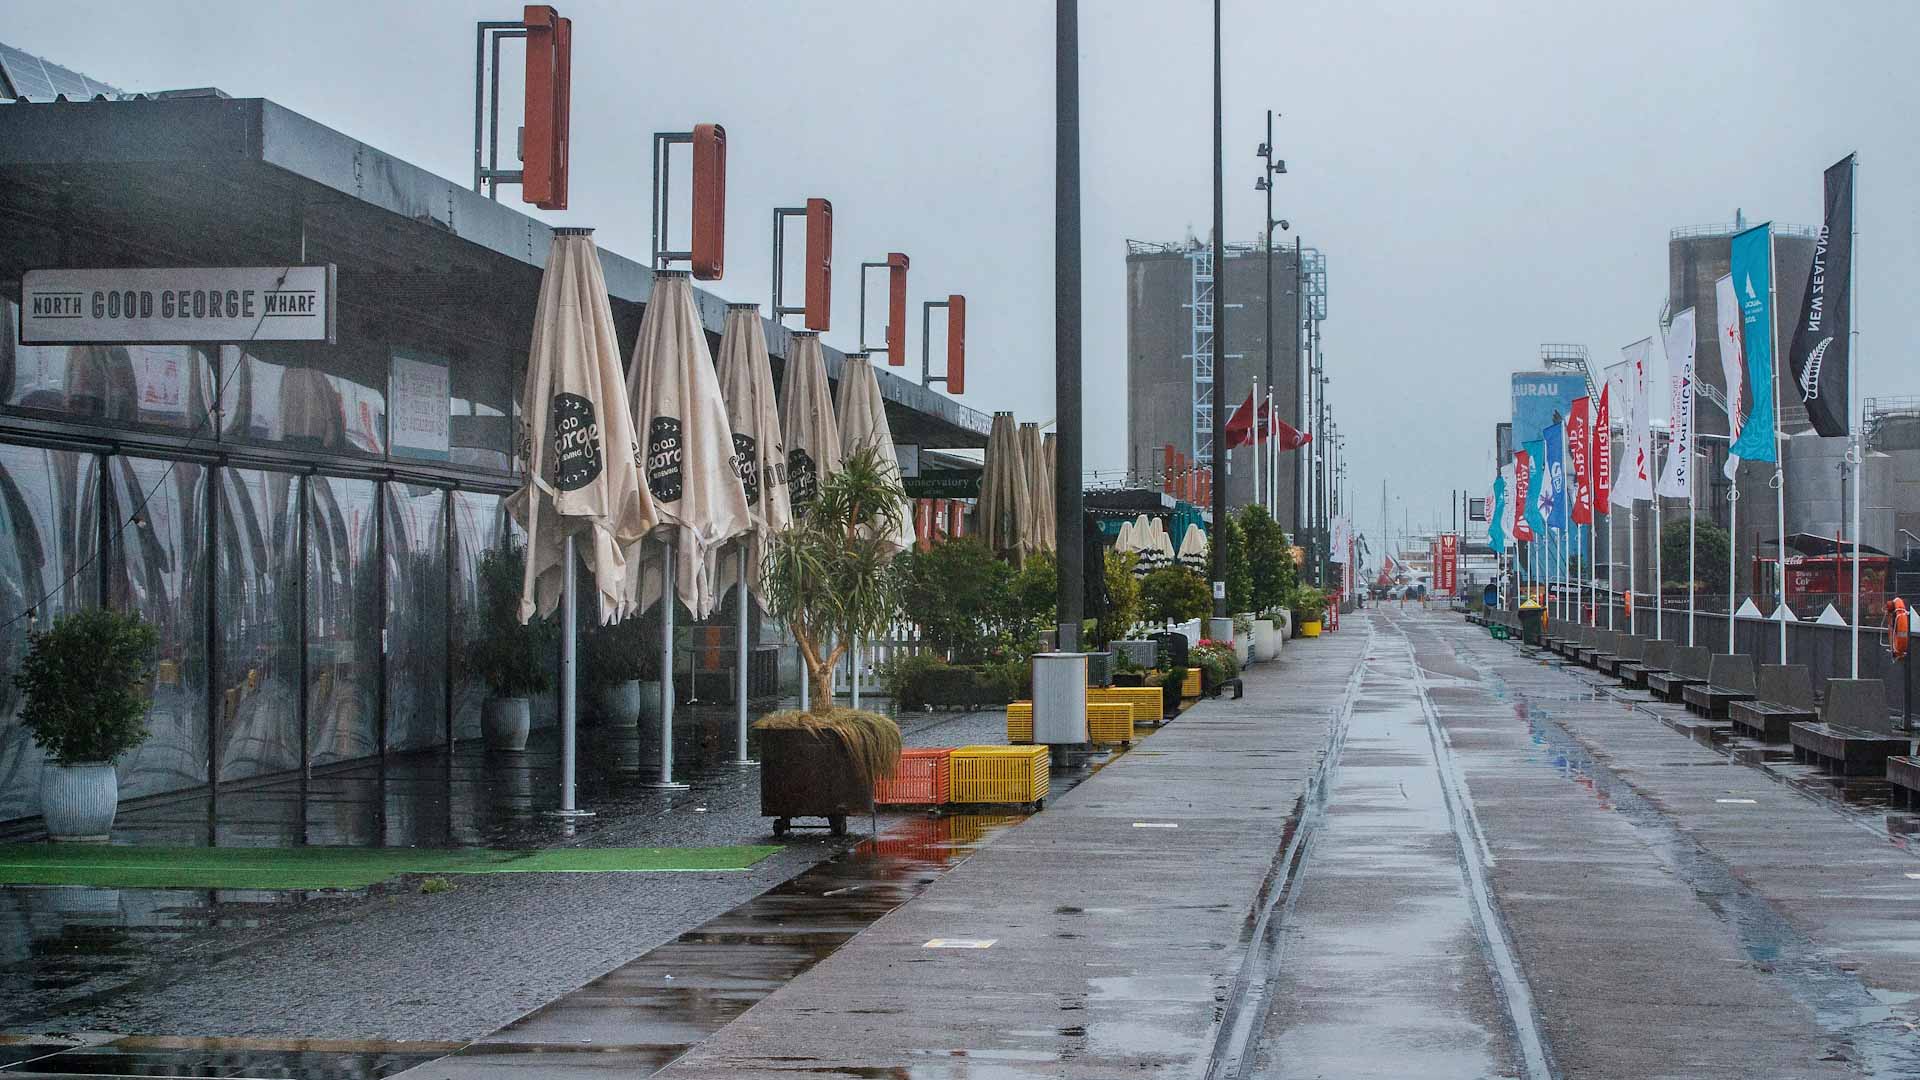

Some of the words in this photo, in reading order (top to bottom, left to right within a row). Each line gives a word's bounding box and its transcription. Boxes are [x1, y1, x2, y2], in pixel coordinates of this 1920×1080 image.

[33, 297, 82, 314] NORTH
[91, 290, 153, 319] GOOD
[161, 289, 255, 319] GEORGE
[264, 295, 316, 313] WHARF
